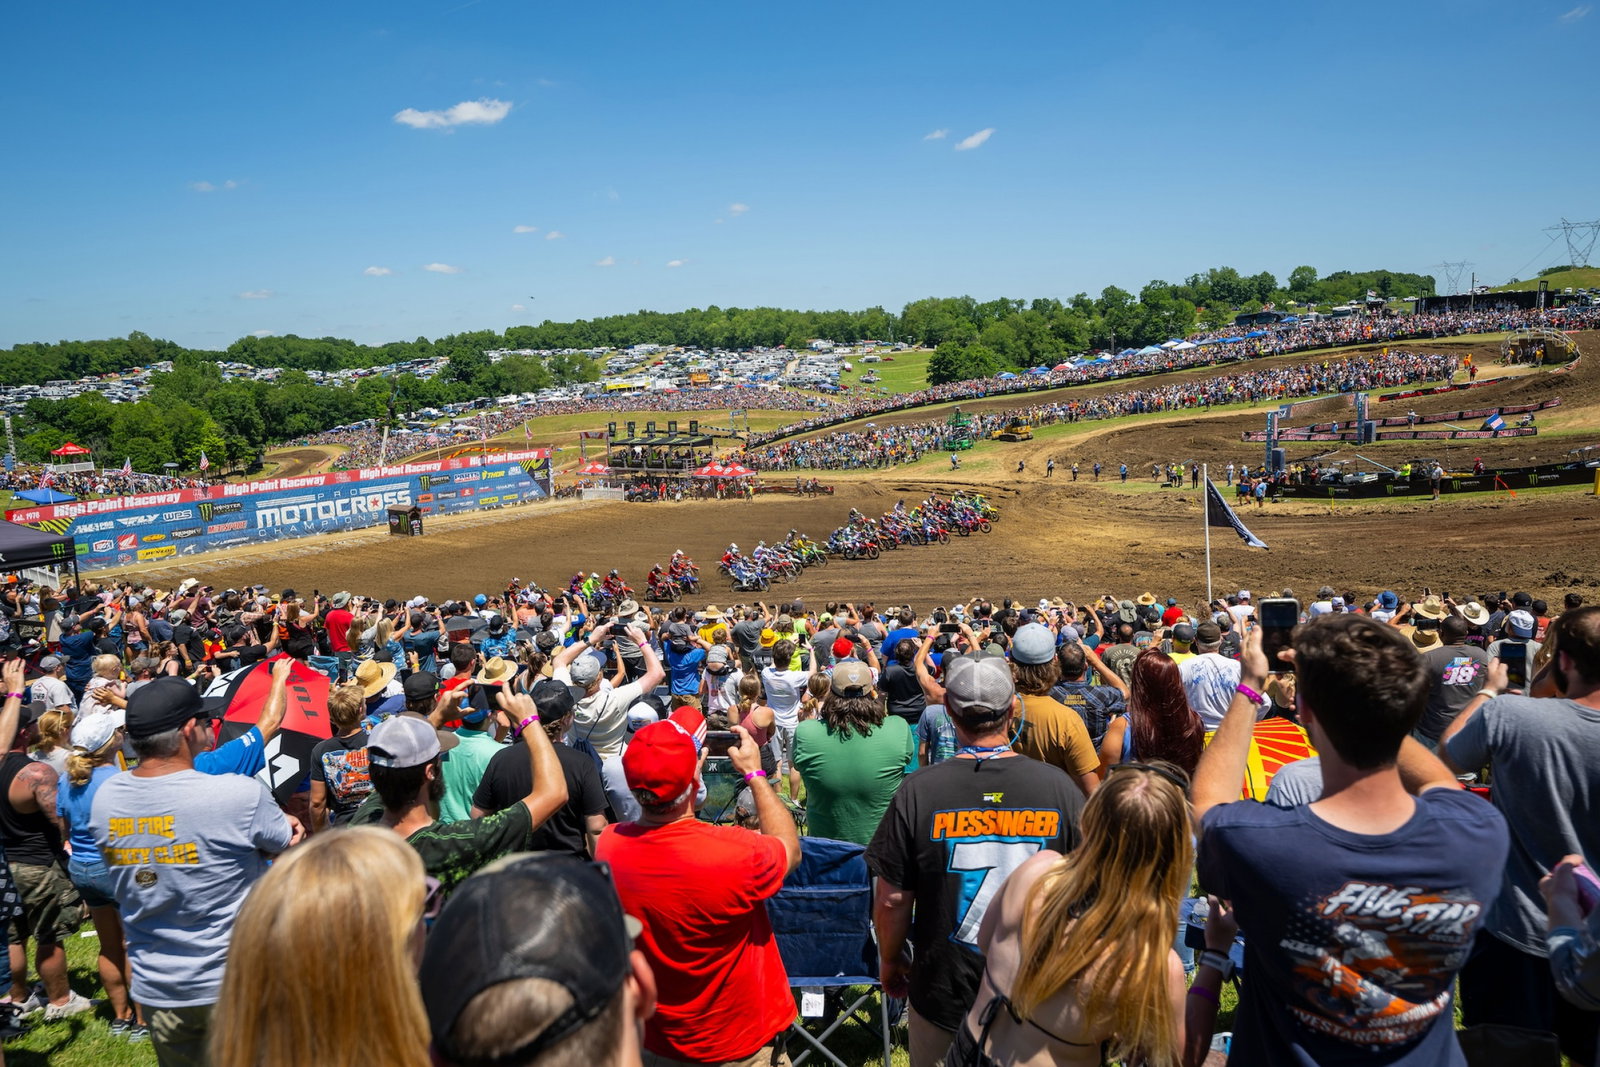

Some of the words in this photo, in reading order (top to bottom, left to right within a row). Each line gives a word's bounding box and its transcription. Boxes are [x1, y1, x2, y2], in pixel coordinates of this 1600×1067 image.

[507, 451, 538, 462] Raceway
[360, 468, 380, 480] High
[381, 465, 404, 476] Point
[405, 462, 442, 474] Raceway
[454, 472, 480, 480] PARTS
[223, 483, 250, 496] High
[250, 480, 279, 492] Point
[280, 476, 325, 489] Raceway
[317, 488, 358, 500] PRO
[53, 503, 86, 518] High
[87, 497, 123, 513] Point
[124, 492, 181, 508] Raceway
[213, 502, 242, 511] MONSTER
[256, 490, 412, 529] MOTOCROSS
[116, 514, 160, 526] FLY
[163, 510, 192, 521] WPS
[172, 528, 200, 538] TRIUMPH
[145, 548, 175, 557] DUNLOP
[1444, 666, 1475, 685] 18
[109, 817, 135, 841] PGH
[138, 815, 175, 840] FIRE
[932, 810, 1060, 839] PLESSINGER
[154, 842, 199, 864] CLUB
[952, 842, 1042, 945] 7
[1324, 883, 1424, 918] FIVE
[1386, 903, 1481, 935] STAR
